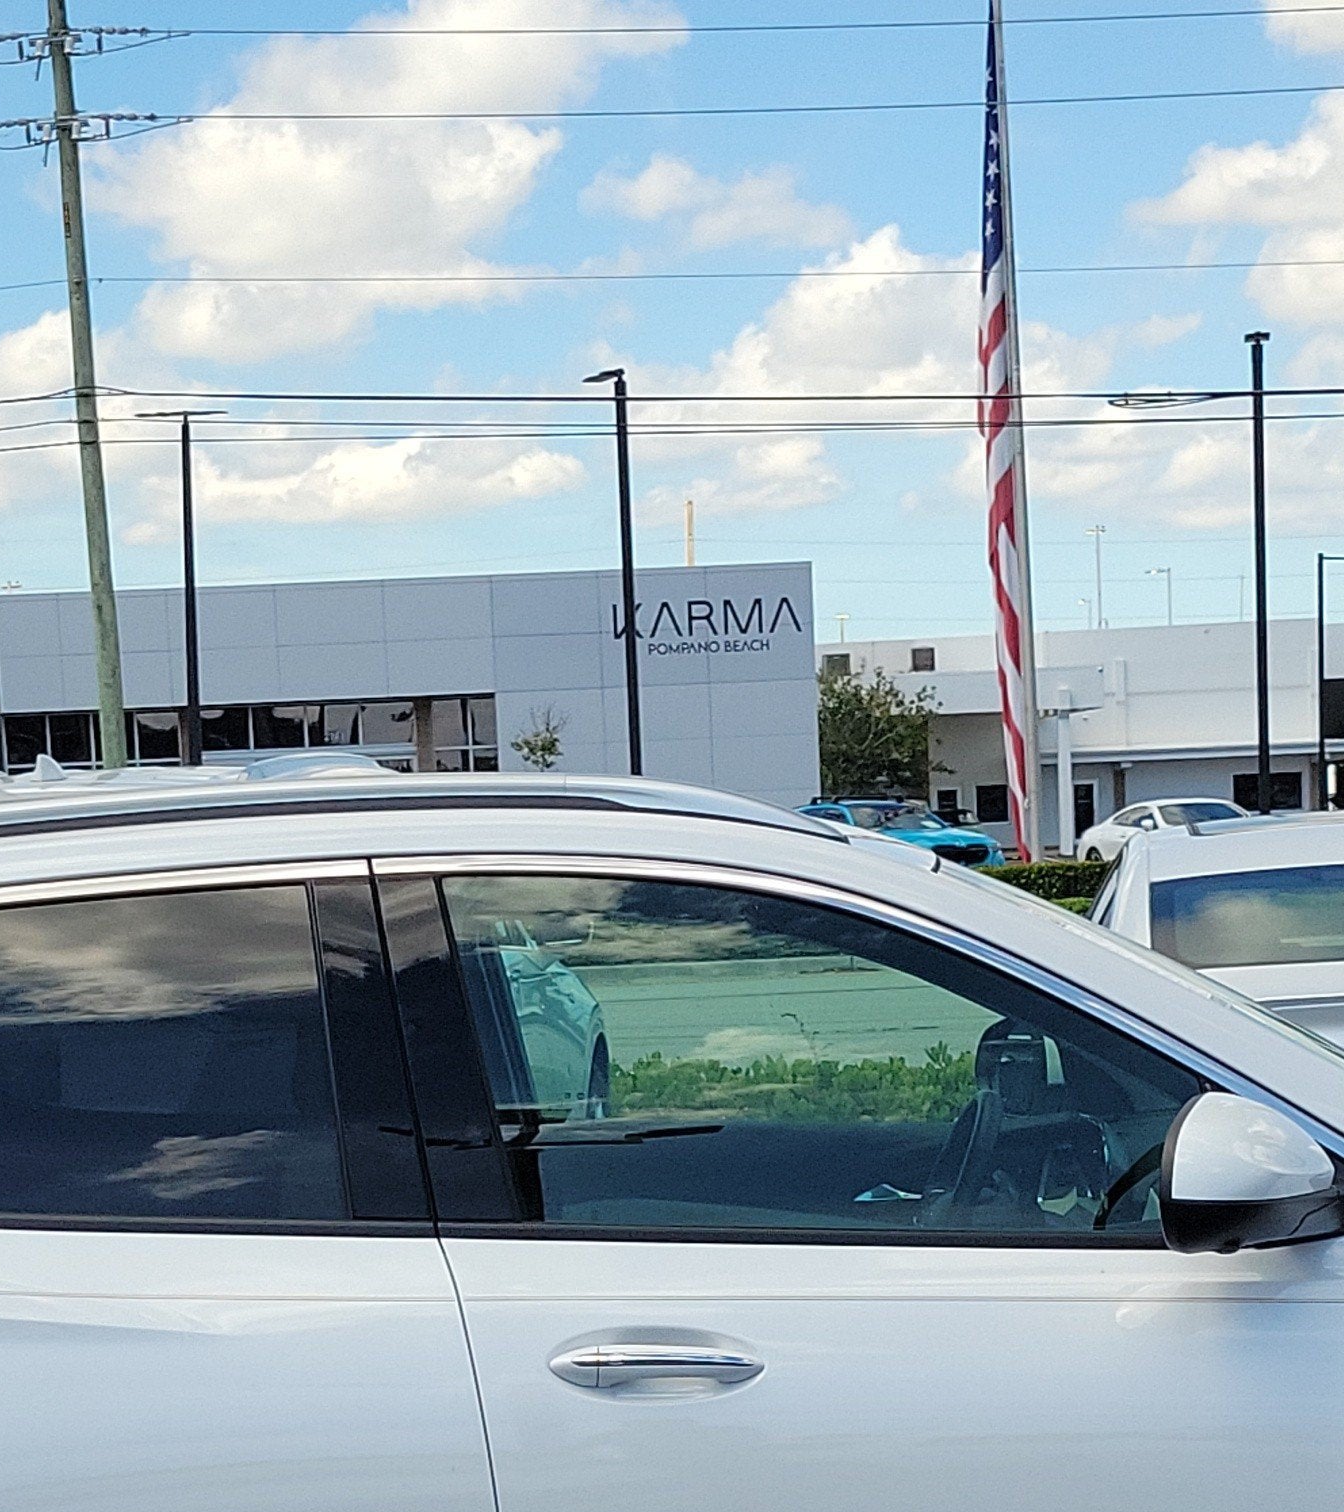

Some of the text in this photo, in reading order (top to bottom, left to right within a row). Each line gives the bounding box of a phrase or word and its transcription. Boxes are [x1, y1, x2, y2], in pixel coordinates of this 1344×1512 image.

[612, 597, 802, 640] KARMA
[648, 638, 770, 656] POMPANO BEACH
